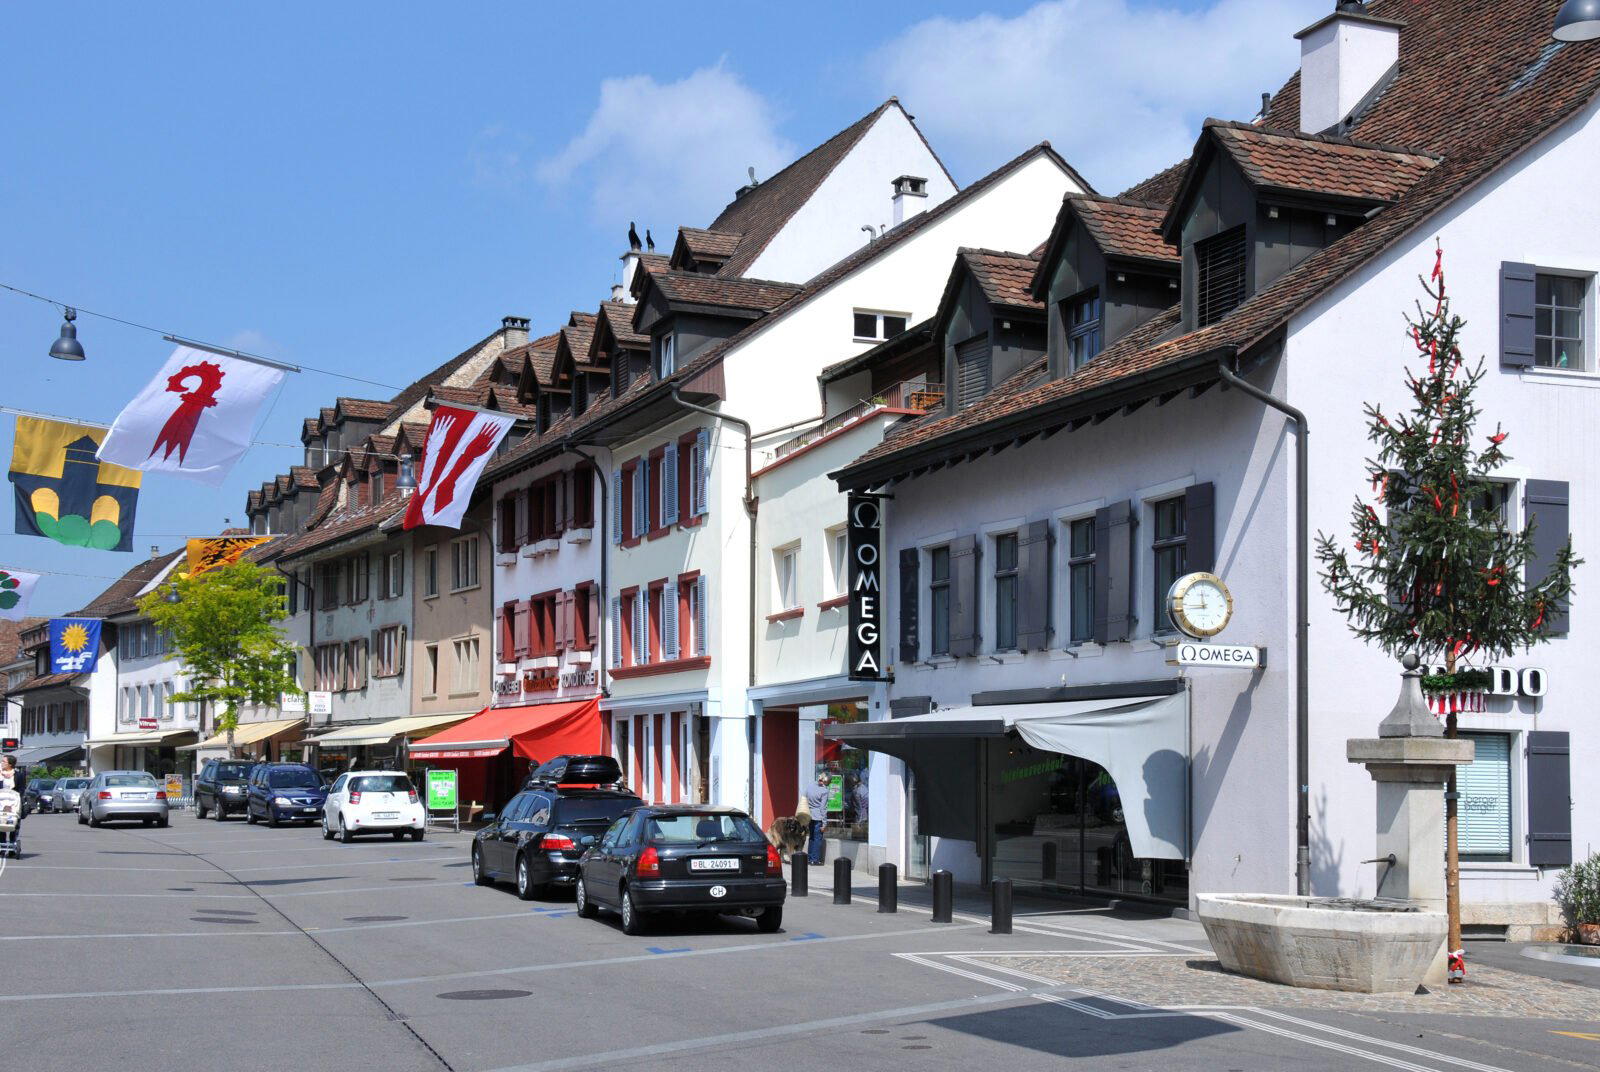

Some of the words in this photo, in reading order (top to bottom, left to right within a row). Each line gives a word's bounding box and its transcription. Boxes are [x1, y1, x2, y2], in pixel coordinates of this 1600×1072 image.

[854, 543, 880, 672] OMEGA
[1199, 647, 1254, 662] OMEGA
[698, 860, 707, 869] BL
[711, 859, 732, 869] 24091
[712, 887, 725, 896] CH
